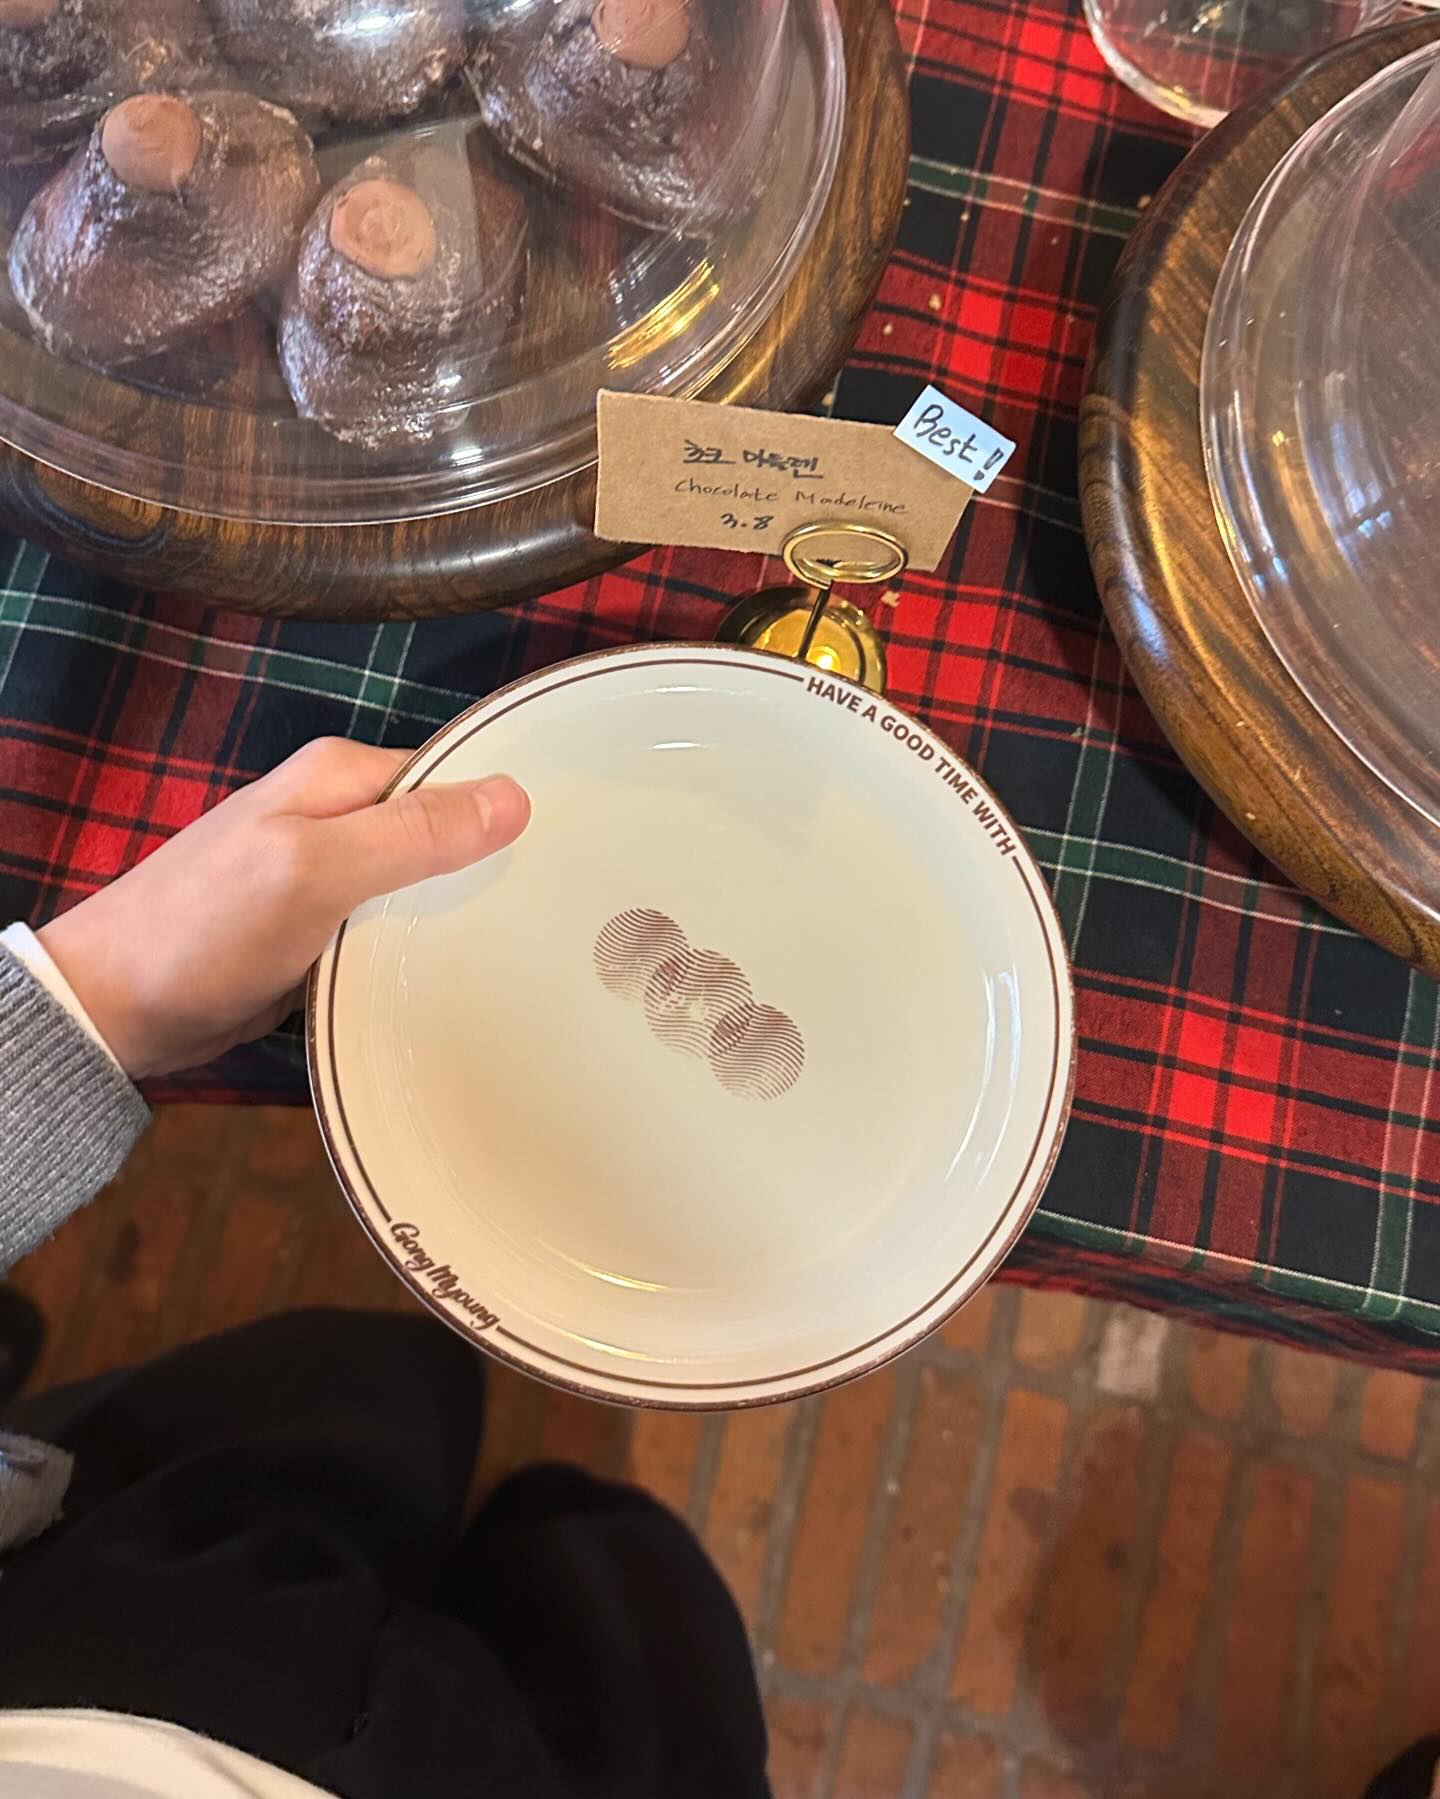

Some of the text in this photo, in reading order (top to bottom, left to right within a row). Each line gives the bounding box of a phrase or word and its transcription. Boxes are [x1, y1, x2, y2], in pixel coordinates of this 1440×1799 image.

[913, 403, 1005, 481] Best!
[742, 449, 825, 479] 마들렌
[673, 478, 908, 514] Chocolate Madeleine
[720, 513, 774, 531] 3.8
[806, 676, 1017, 856] HAVE A GOOD TIME WITH
[390, 1222, 435, 1272] Gong
